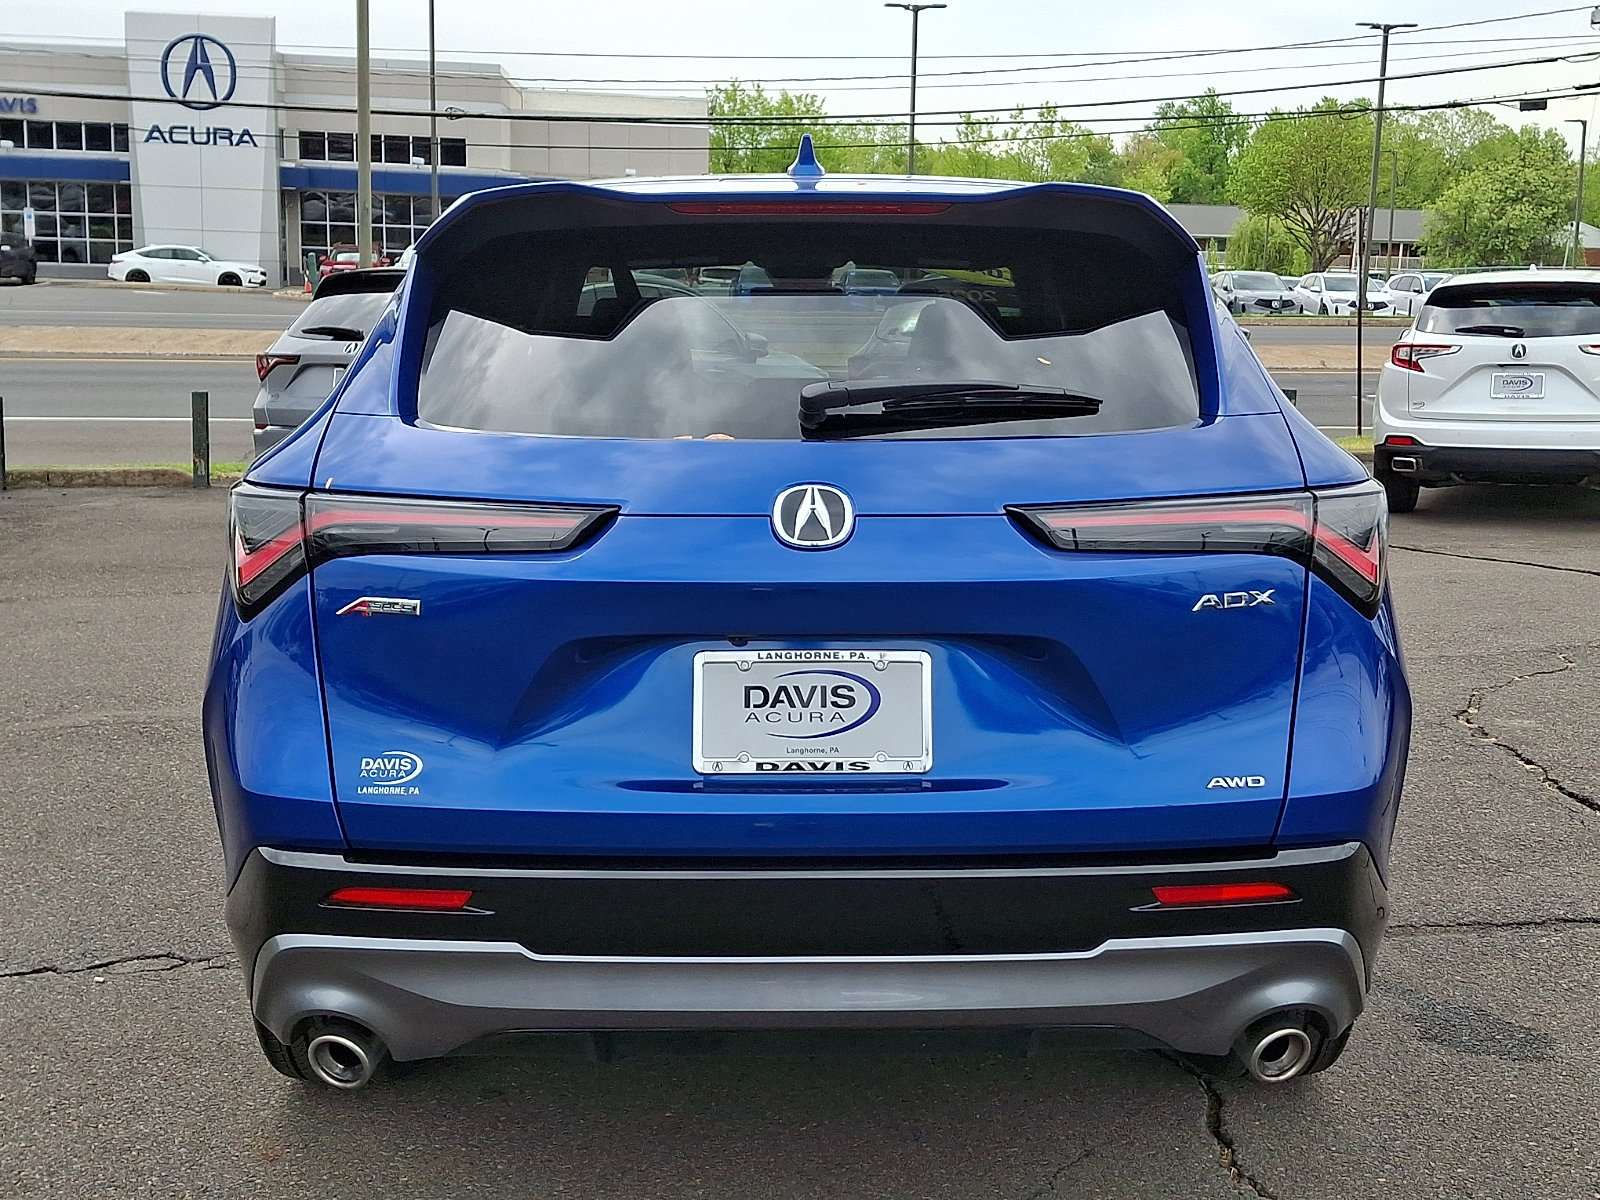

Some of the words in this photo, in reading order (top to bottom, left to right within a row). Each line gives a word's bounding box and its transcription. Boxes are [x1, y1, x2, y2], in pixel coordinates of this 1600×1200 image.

[143, 123, 258, 148] ACURA
[1192, 588, 1276, 612] ADX
[757, 651, 845, 660] LANGHORNE,
[849, 651, 870, 660] PA.
[743, 684, 857, 709] DAVIS
[744, 711, 846, 723] ACURA
[786, 747, 828, 755] Langhorne,
[360, 757, 412, 771] DAVIS
[755, 761, 871, 771] DAVIS
[359, 769, 406, 778] ACURA
[1206, 776, 1266, 789] AWD
[357, 786, 408, 795] LANGHORNE,
[408, 786, 420, 795] PA
